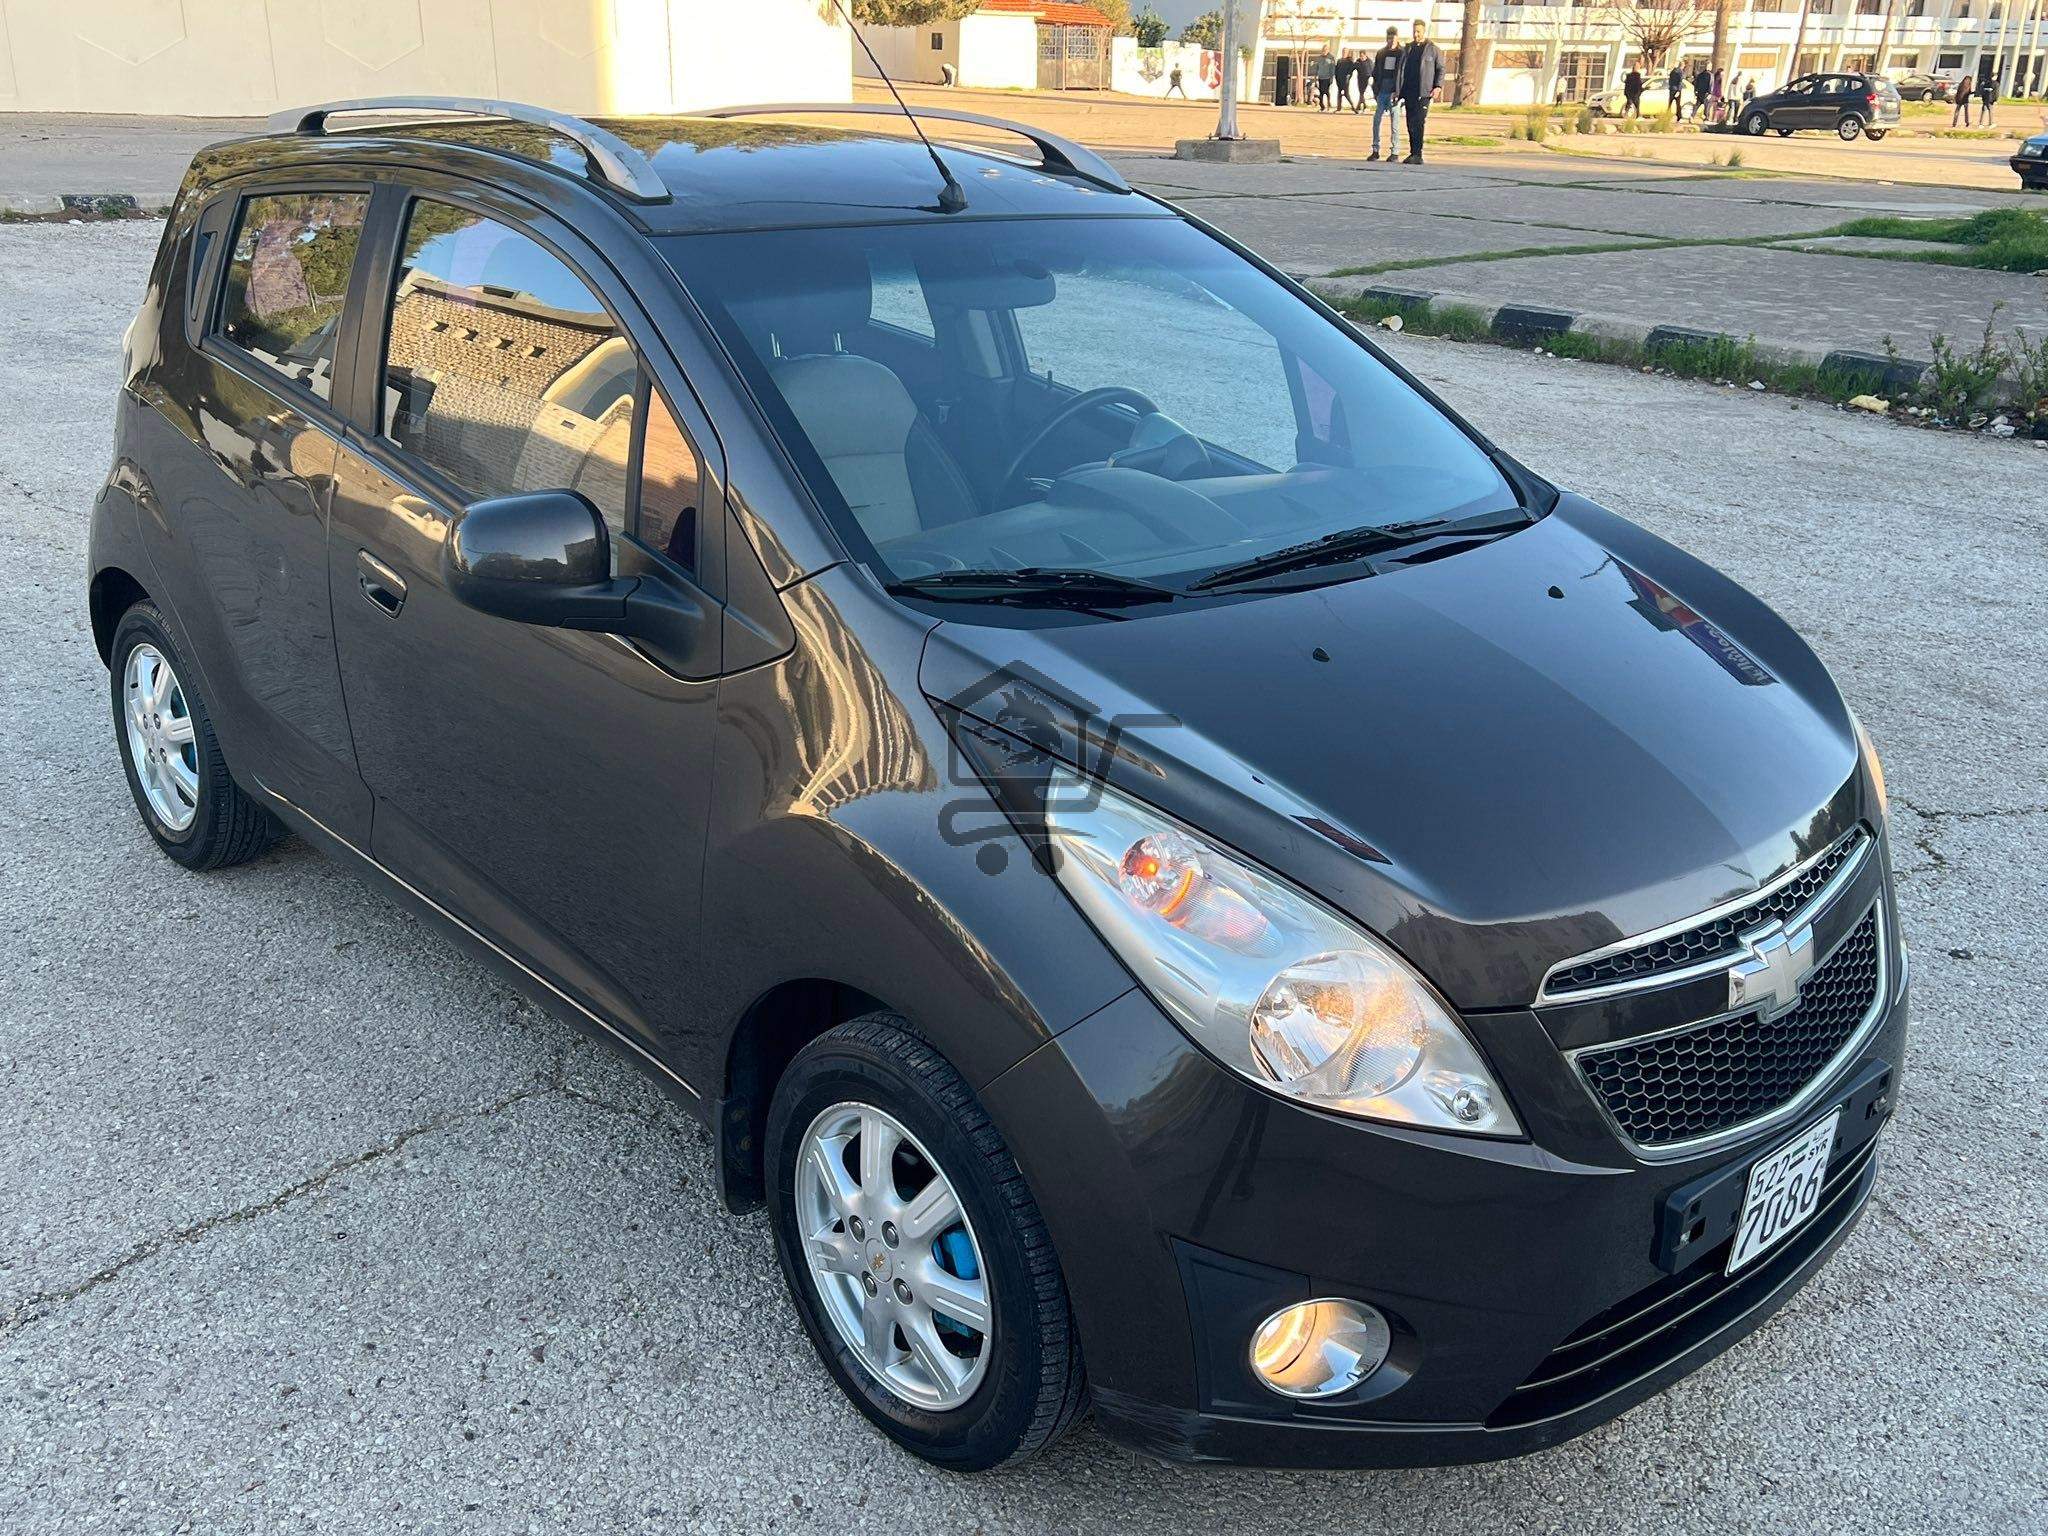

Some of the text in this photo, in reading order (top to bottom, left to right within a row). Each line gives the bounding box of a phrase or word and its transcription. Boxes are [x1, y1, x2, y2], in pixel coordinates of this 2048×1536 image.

[1808, 1138, 1828, 1161] SYR
[1752, 1153, 1791, 1202] 522
[1738, 1157, 1824, 1260] 7086
